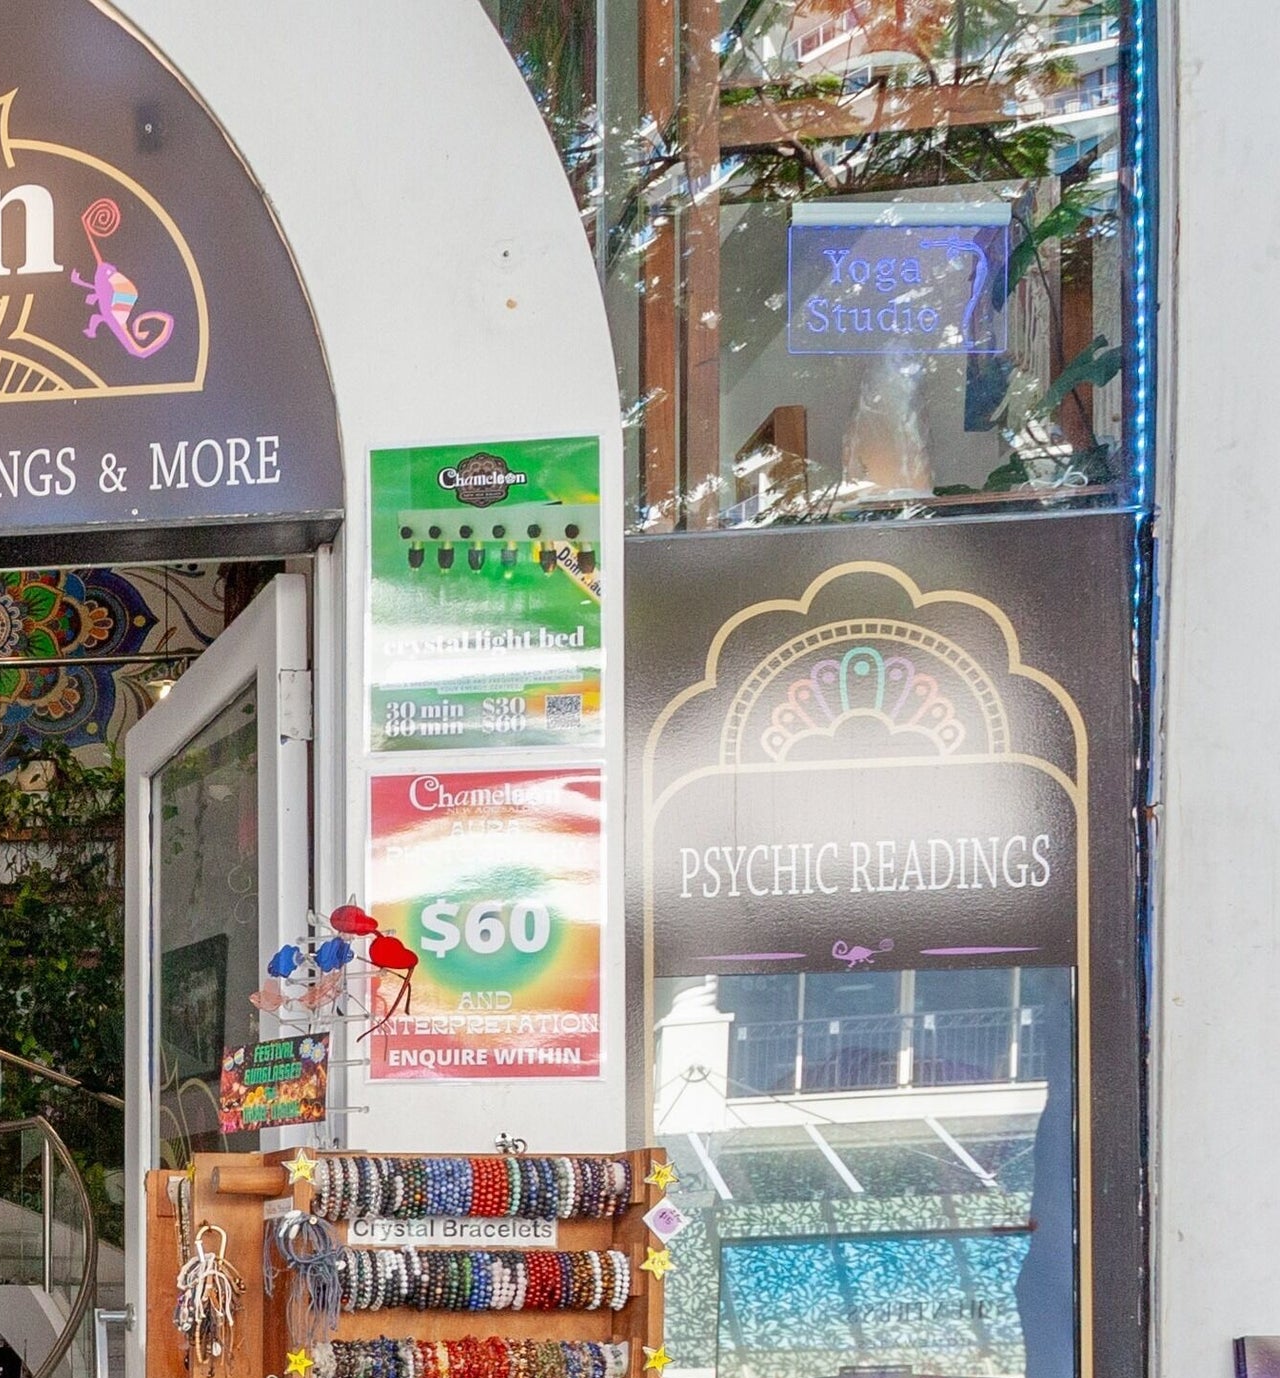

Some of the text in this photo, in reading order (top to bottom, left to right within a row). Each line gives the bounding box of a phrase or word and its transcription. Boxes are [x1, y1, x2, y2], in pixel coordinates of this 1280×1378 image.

[822, 248, 922, 292] Yoga
[806, 298, 940, 335] Studio
[98, 452, 127, 493] &
[149, 435, 281, 489] MORE
[438, 467, 527, 489] Chameleon
[539, 626, 584, 648] bed
[386, 696, 526, 719] 30 min $30
[385, 717, 416, 737] 60
[409, 775, 560, 811] Chamel
[680, 834, 1051, 899] PSYCHIC READINGS
[420, 899, 550, 958] $60
[458, 991, 513, 1011] AND
[389, 1047, 581, 1067] ENQUIRE WITHIN
[353, 1218, 552, 1242] Crystal Bracelets
